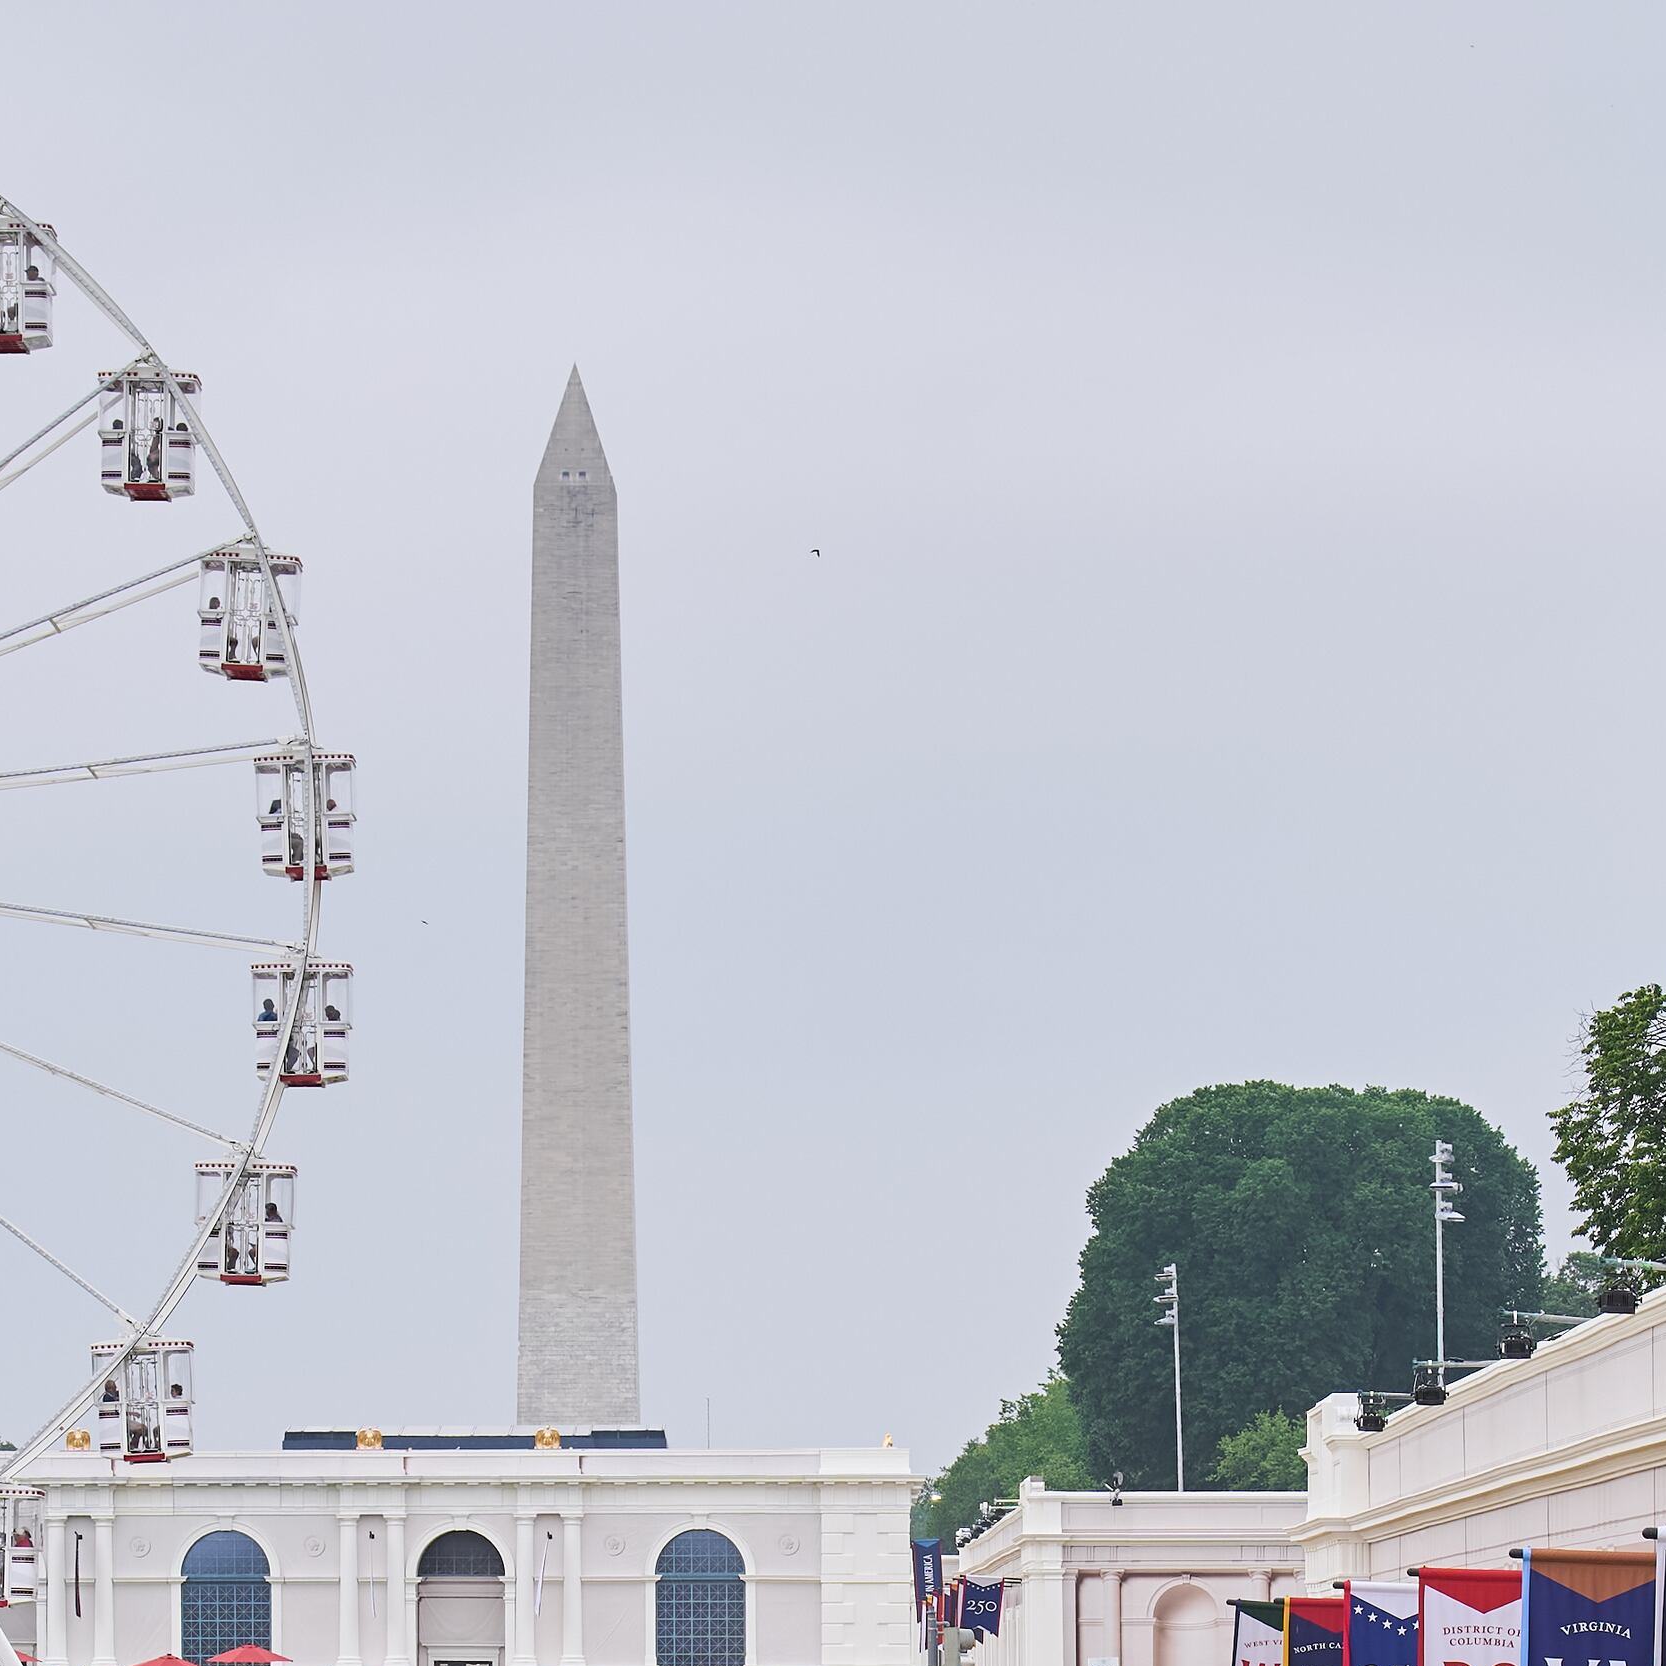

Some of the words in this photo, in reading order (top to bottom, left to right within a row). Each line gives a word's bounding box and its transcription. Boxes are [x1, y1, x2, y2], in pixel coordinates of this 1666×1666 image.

[922, 1554, 934, 1584] AMERICA
[966, 1600, 997, 1615] 250
[1443, 1625, 1503, 1636] DISTRICT
[1560, 1621, 1631, 1640] VIRGINIA
[1244, 1640, 1270, 1649] WEST
[1449, 1637, 1515, 1648] COLUMBIA
[1293, 1643, 1326, 1654] NORTH
